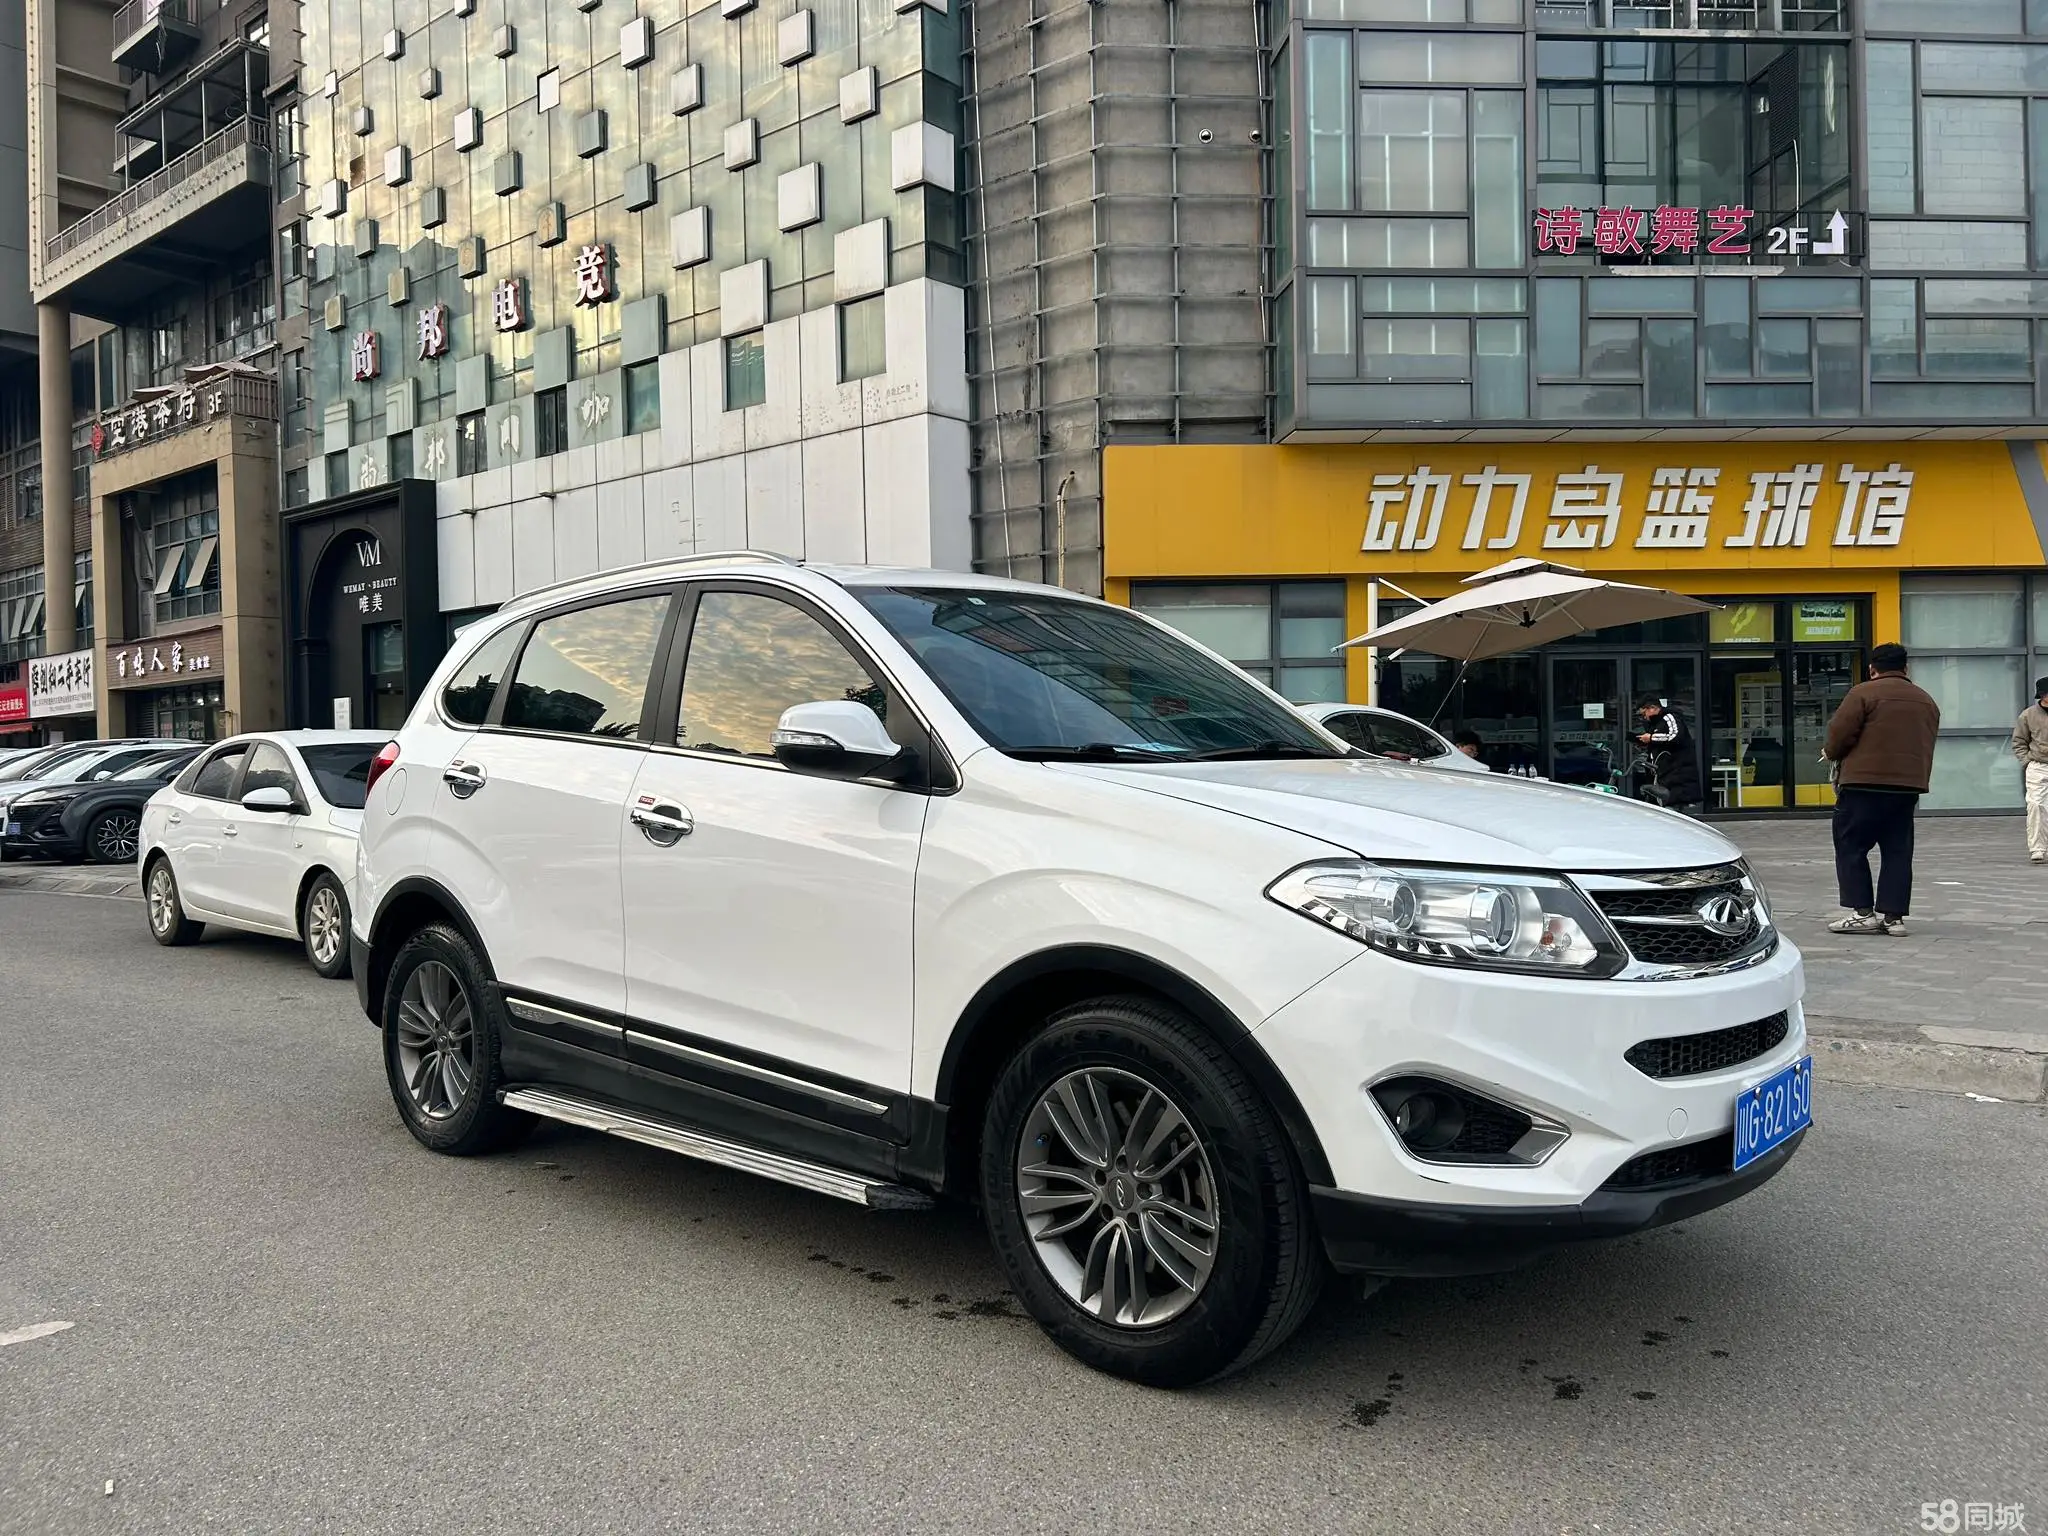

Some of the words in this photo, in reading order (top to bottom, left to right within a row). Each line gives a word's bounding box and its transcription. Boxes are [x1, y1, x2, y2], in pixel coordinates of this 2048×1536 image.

[1534, 204, 1754, 255] 诗敏舞艺
[1767, 227, 1808, 254] 2F
[352, 245, 609, 382] 尚邦电竞
[208, 391, 222, 415] 3F
[1361, 463, 1915, 551] 动力岛篮球馆
[372, 577, 397, 589] BEAUTY
[359, 592, 383, 613] 唯美
[116, 641, 183, 677] 百味人家
